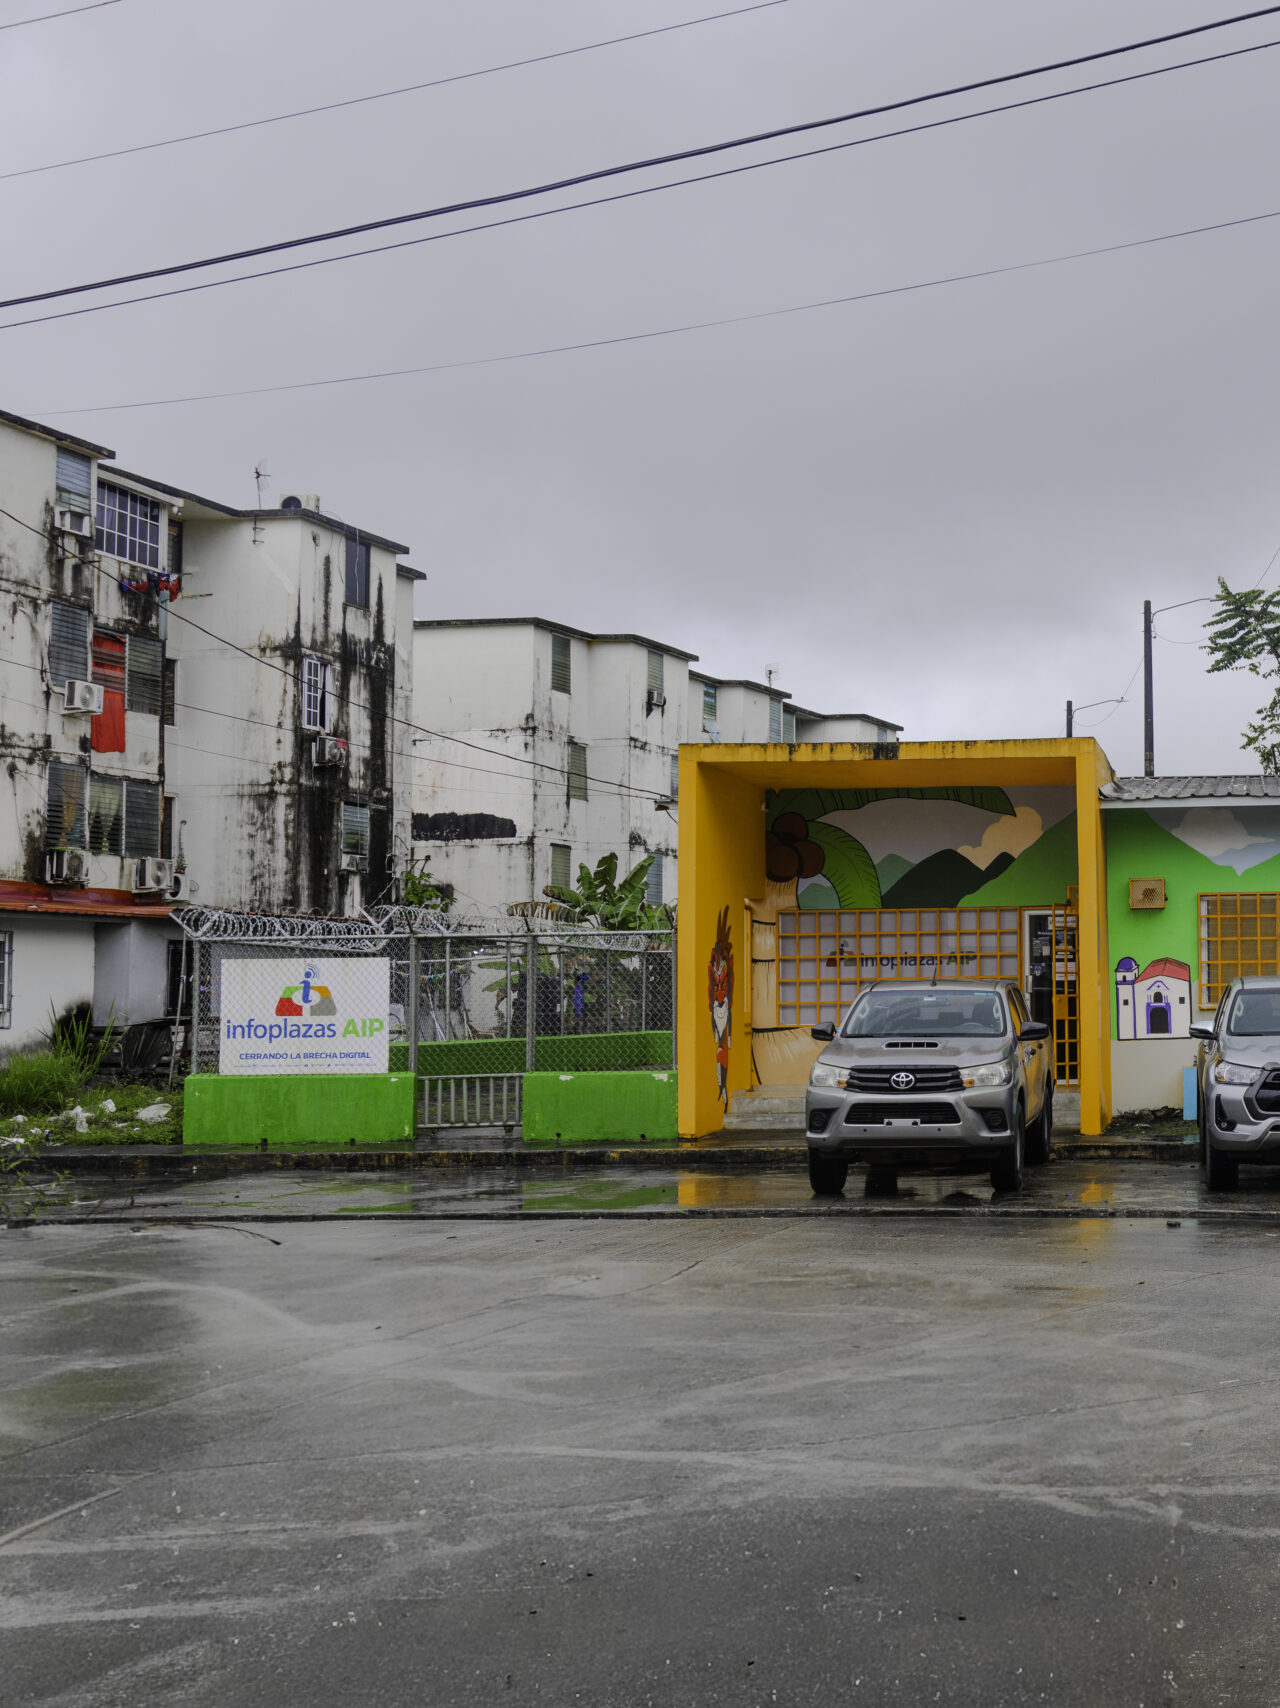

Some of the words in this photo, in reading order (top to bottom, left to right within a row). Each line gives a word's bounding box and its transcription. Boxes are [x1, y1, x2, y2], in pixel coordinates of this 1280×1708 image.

[226, 1018, 337, 1043] infoplazas
[341, 1018, 384, 1038] AIP
[239, 1052, 288, 1060] CERRANDO
[290, 1052, 301, 1060] LA
[303, 1052, 338, 1060] BRECHA
[339, 1051, 371, 1059] DIGITAL
